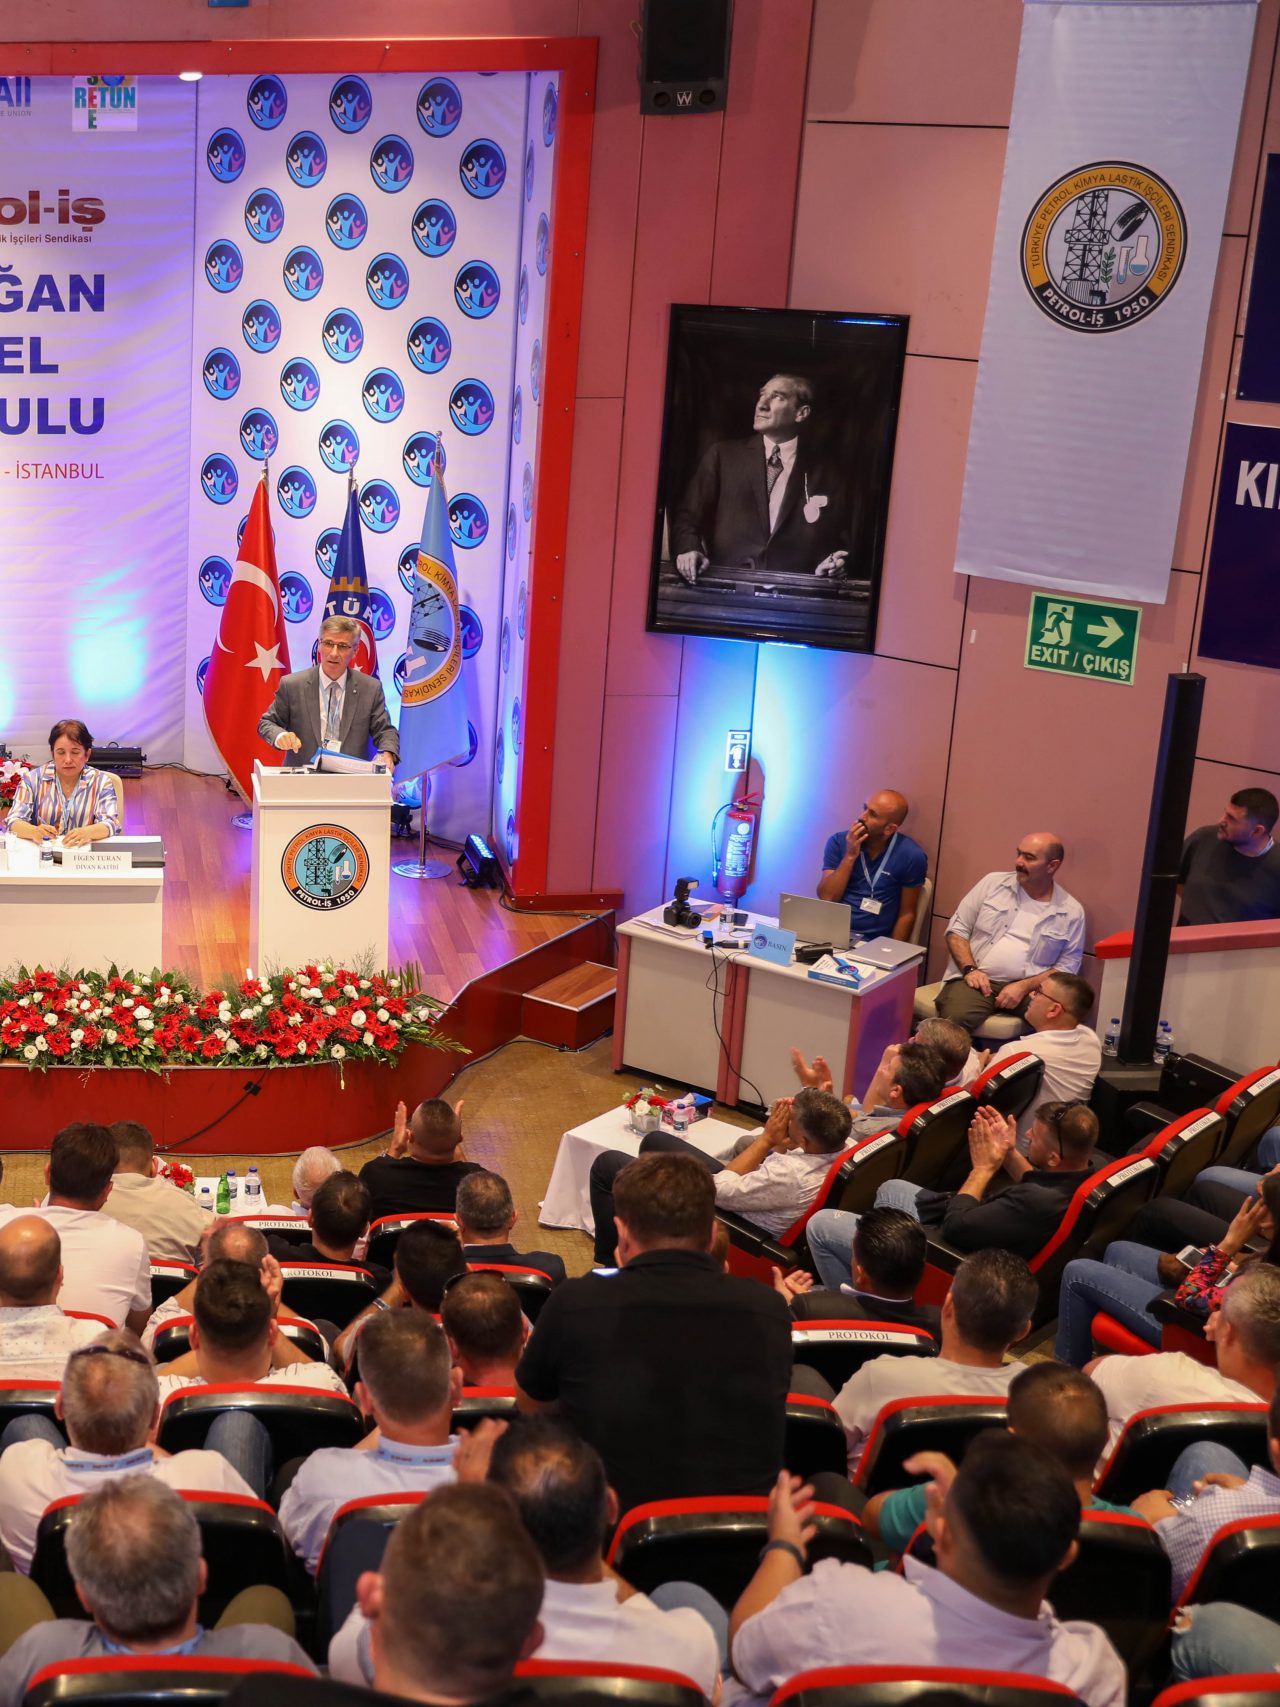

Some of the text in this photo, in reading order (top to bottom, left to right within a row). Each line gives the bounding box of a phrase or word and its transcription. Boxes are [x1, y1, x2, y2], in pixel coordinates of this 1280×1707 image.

[1030, 174, 1176, 282] TÜRKİYE PETROL KİMYA LASTİK İŞÇİLERİ SENDİKASI
[10, 232, 42, 246] İşçileri
[44, 234, 92, 244] Sendikası
[1042, 288, 1149, 327] PETROL-İŞ 1950
[16, 460, 104, 480] İSTANBUL
[1235, 460, 1280, 510] KI
[1030, 645, 1130, 679] EXIT / ÇIKIŞ
[305, 828, 322, 839] KİMYA
[296, 890, 355, 908] PETROL-İŞ 1950
[767, 941, 788, 951] BASIN
[828, 1330, 892, 1342] PROTOKOL
